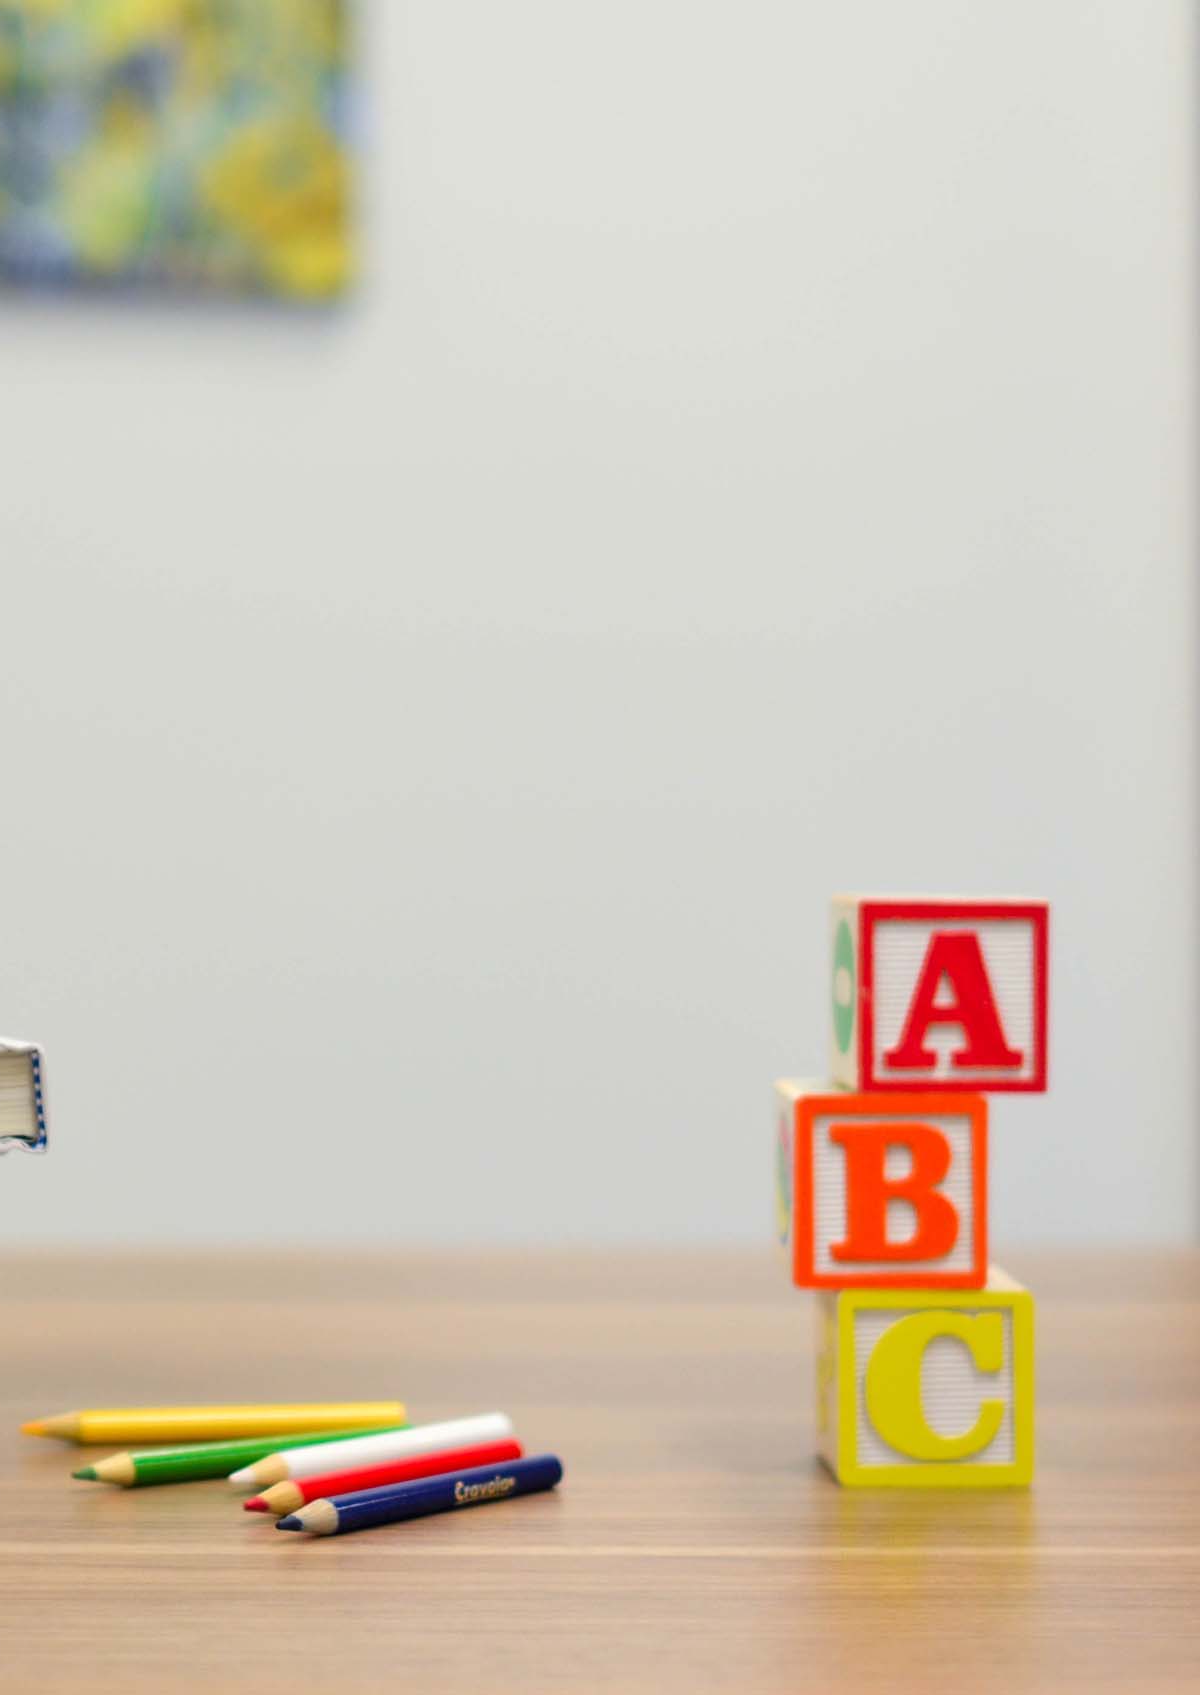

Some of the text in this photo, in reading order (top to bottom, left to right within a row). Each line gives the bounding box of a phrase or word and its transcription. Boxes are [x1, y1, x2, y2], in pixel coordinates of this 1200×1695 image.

[883, 931, 1023, 1069] A
[828, 1123, 959, 1263] B
[865, 1309, 1005, 1461] C
